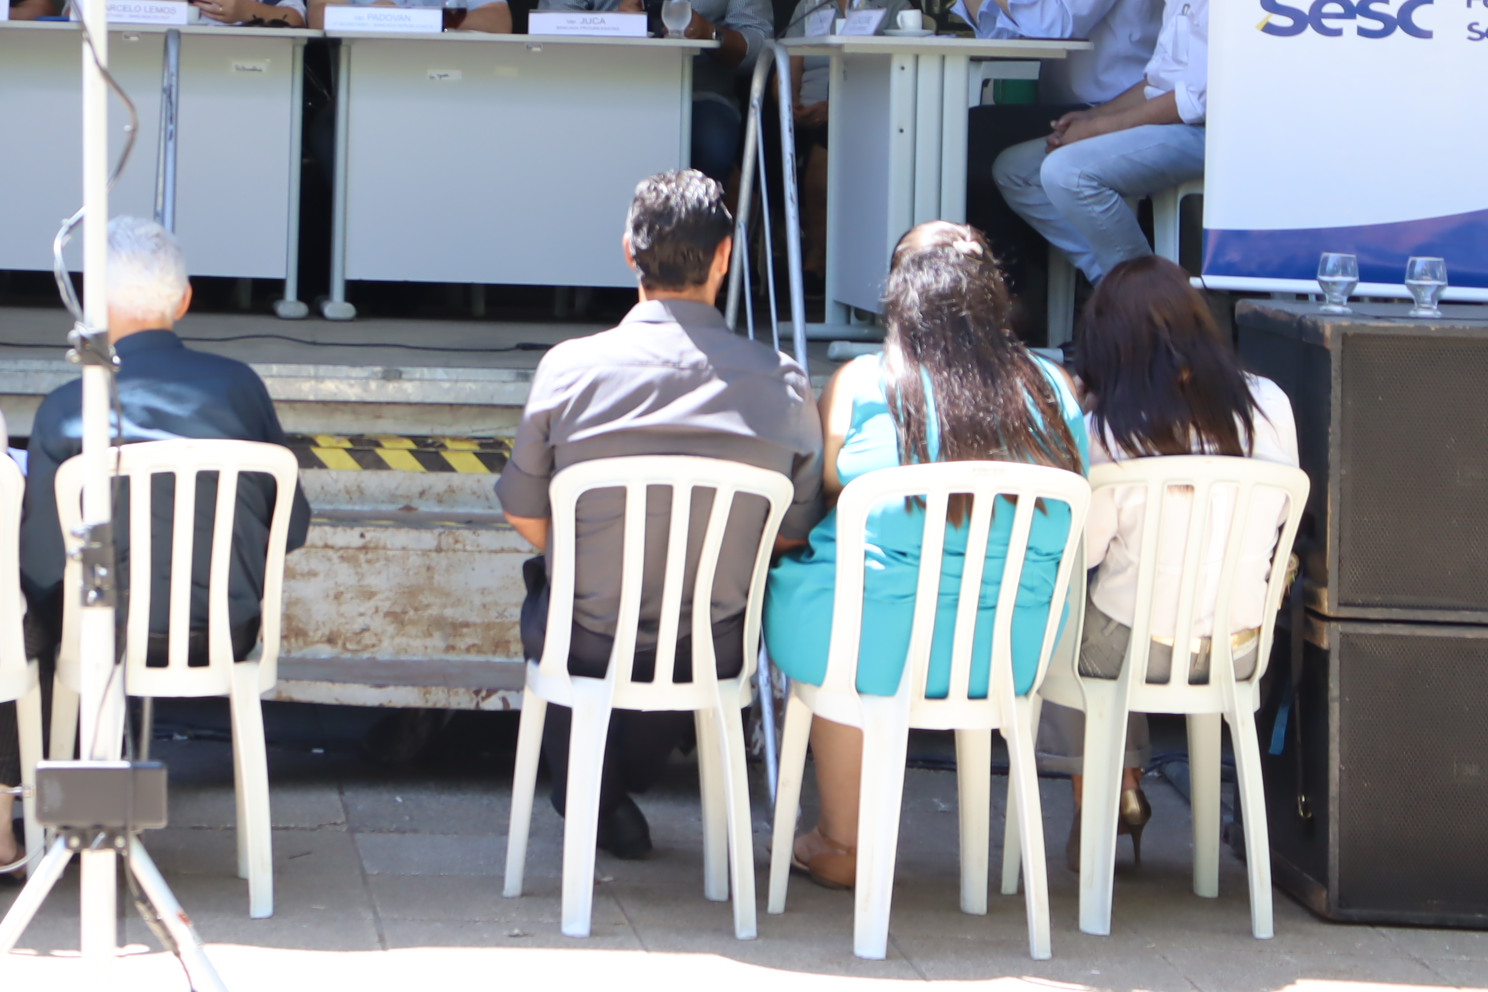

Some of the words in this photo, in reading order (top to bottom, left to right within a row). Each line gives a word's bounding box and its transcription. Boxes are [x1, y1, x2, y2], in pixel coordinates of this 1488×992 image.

[143, 5, 176, 14] LEMOS
[367, 13, 411, 22] PADOVAN
[580, 17, 606, 25] JUCA
